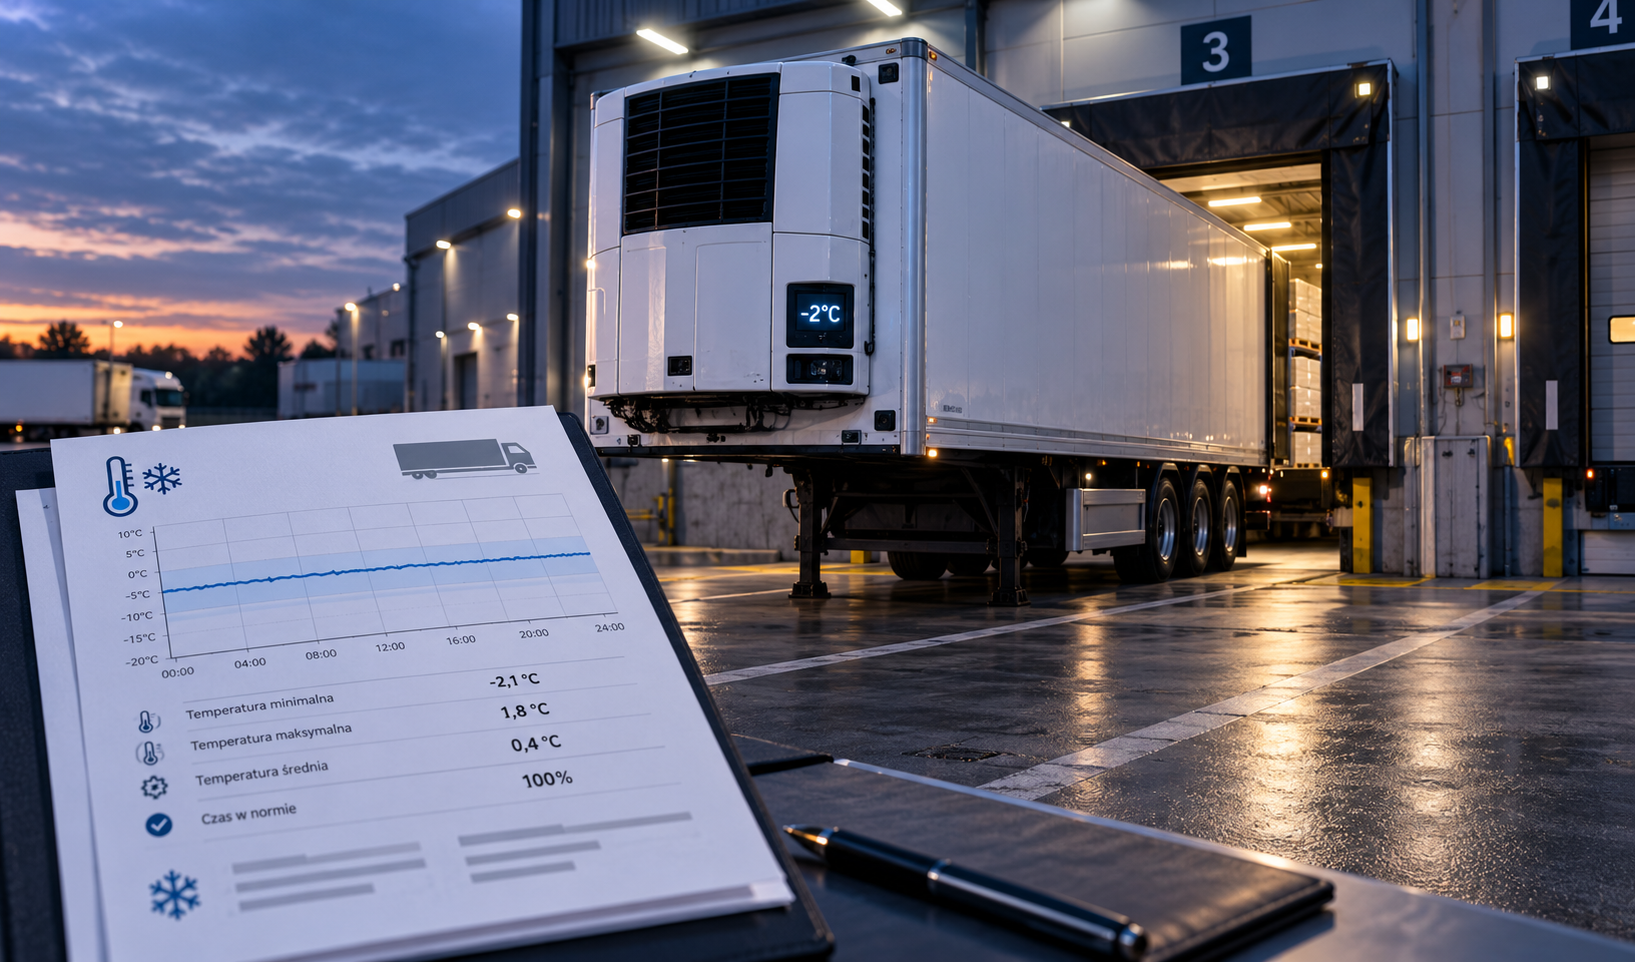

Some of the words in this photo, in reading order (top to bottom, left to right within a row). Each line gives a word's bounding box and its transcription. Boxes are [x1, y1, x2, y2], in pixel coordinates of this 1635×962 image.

[1590, 0, 1623, 34] 4
[1202, 31, 1230, 72] 3
[800, 304, 841, 323] -2°C
[118, 528, 143, 539] 10°C
[126, 548, 145, 558] 5°C
[128, 569, 148, 579] 0°C
[125, 590, 150, 600] -5°C
[121, 611, 153, 622] -10°C
[519, 628, 549, 639] 20:00
[594, 622, 625, 633] 24:00
[123, 632, 156, 644] -15°C
[446, 634, 476, 646] 16:00
[375, 641, 406, 653] 12:00
[125, 655, 159, 667] -20°C
[305, 649, 338, 661] 08:00
[234, 657, 267, 669] 04:00
[161, 666, 195, 679] 00:00
[489, 675, 518, 689] -2,1
[521, 673, 540, 685] °C
[185, 702, 267, 720] Temperatura
[270, 694, 335, 709] minimalna
[500, 705, 527, 720] 1,8
[530, 702, 550, 715] °C
[190, 733, 273, 751] Temperatura
[275, 723, 353, 741] maksymalna
[511, 737, 539, 753] 0,4
[541, 735, 562, 748] °C
[195, 767, 279, 786] Temperatura
[282, 760, 329, 776] średnia
[522, 770, 573, 789] 100%
[201, 812, 233, 825] Czas
[236, 810, 247, 821] w
[250, 803, 297, 819] normie
